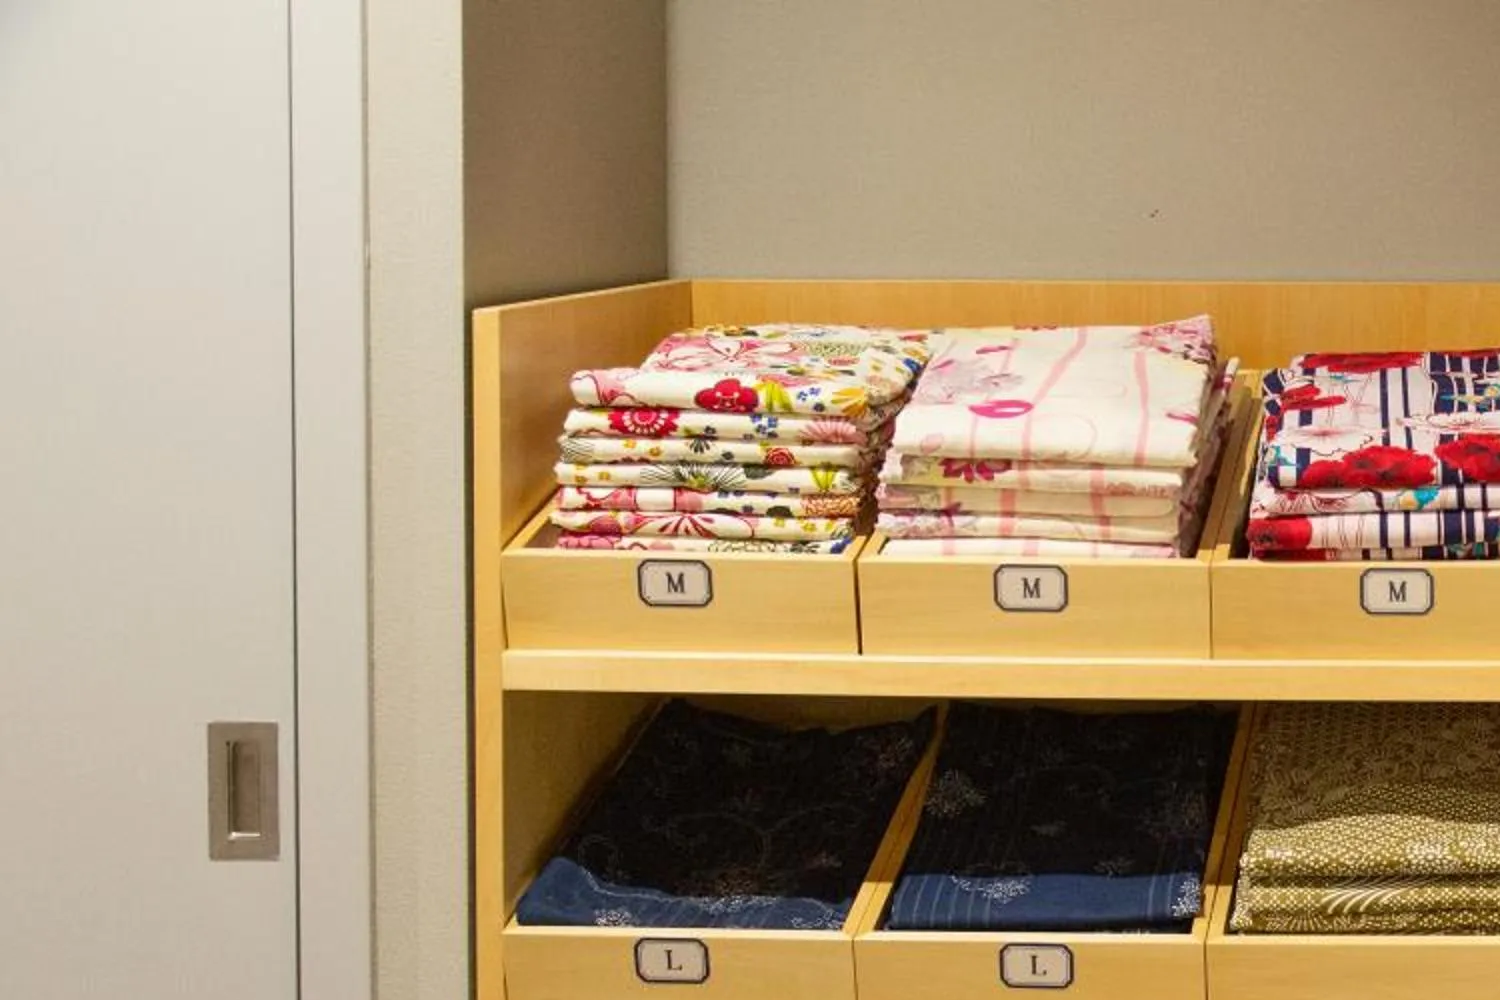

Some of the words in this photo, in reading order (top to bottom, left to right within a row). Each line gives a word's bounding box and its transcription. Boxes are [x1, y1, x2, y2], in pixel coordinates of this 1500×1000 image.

[665, 571, 686, 594] M
[1021, 577, 1041, 599] M
[1388, 580, 1407, 603] M
[664, 949, 683, 971] L
[1030, 954, 1048, 976] L
